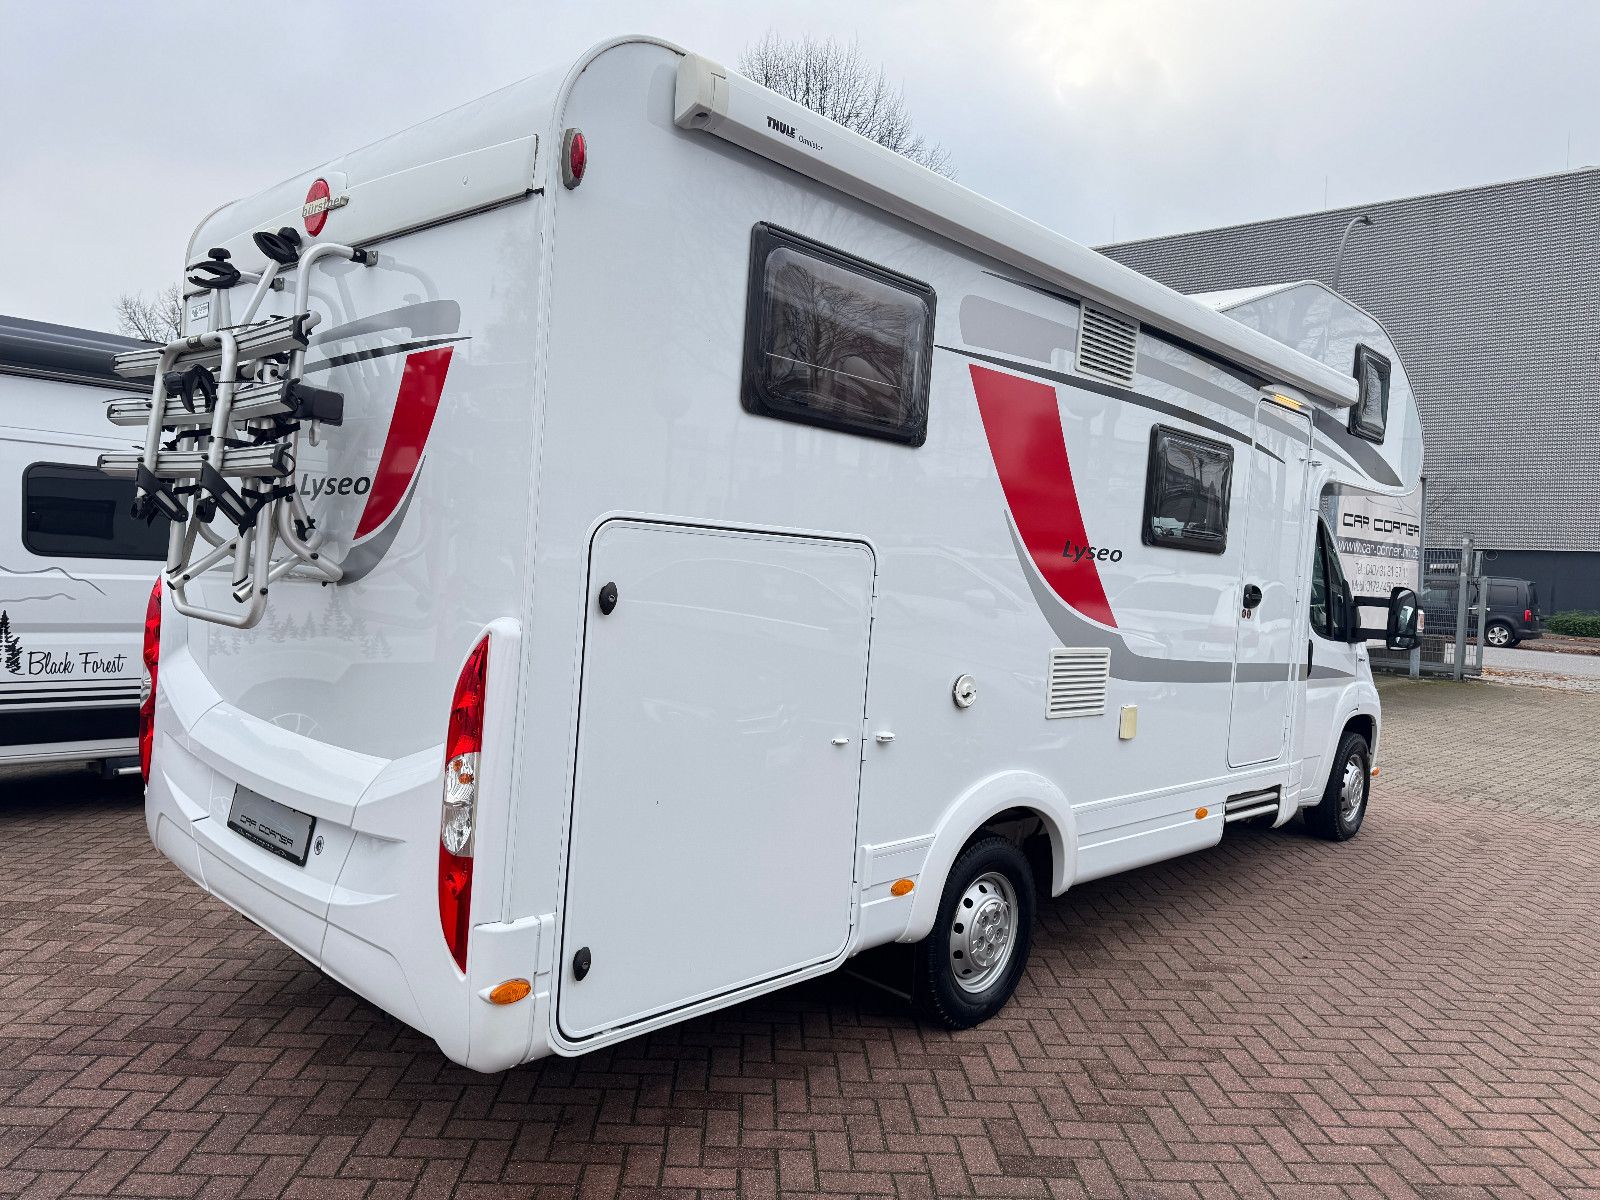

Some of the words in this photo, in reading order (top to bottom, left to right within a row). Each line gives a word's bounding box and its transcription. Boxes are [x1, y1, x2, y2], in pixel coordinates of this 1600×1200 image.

[767, 115, 796, 138] THULE
[300, 473, 371, 501] Lyseo
[1342, 512, 1370, 530] CAR
[1373, 518, 1420, 537] CORNER
[1062, 540, 1123, 563] Lyseo
[27, 651, 75, 675] Black
[79, 651, 128, 673] Forest
[239, 814, 257, 829] CAR
[259, 823, 294, 848] CORNER
